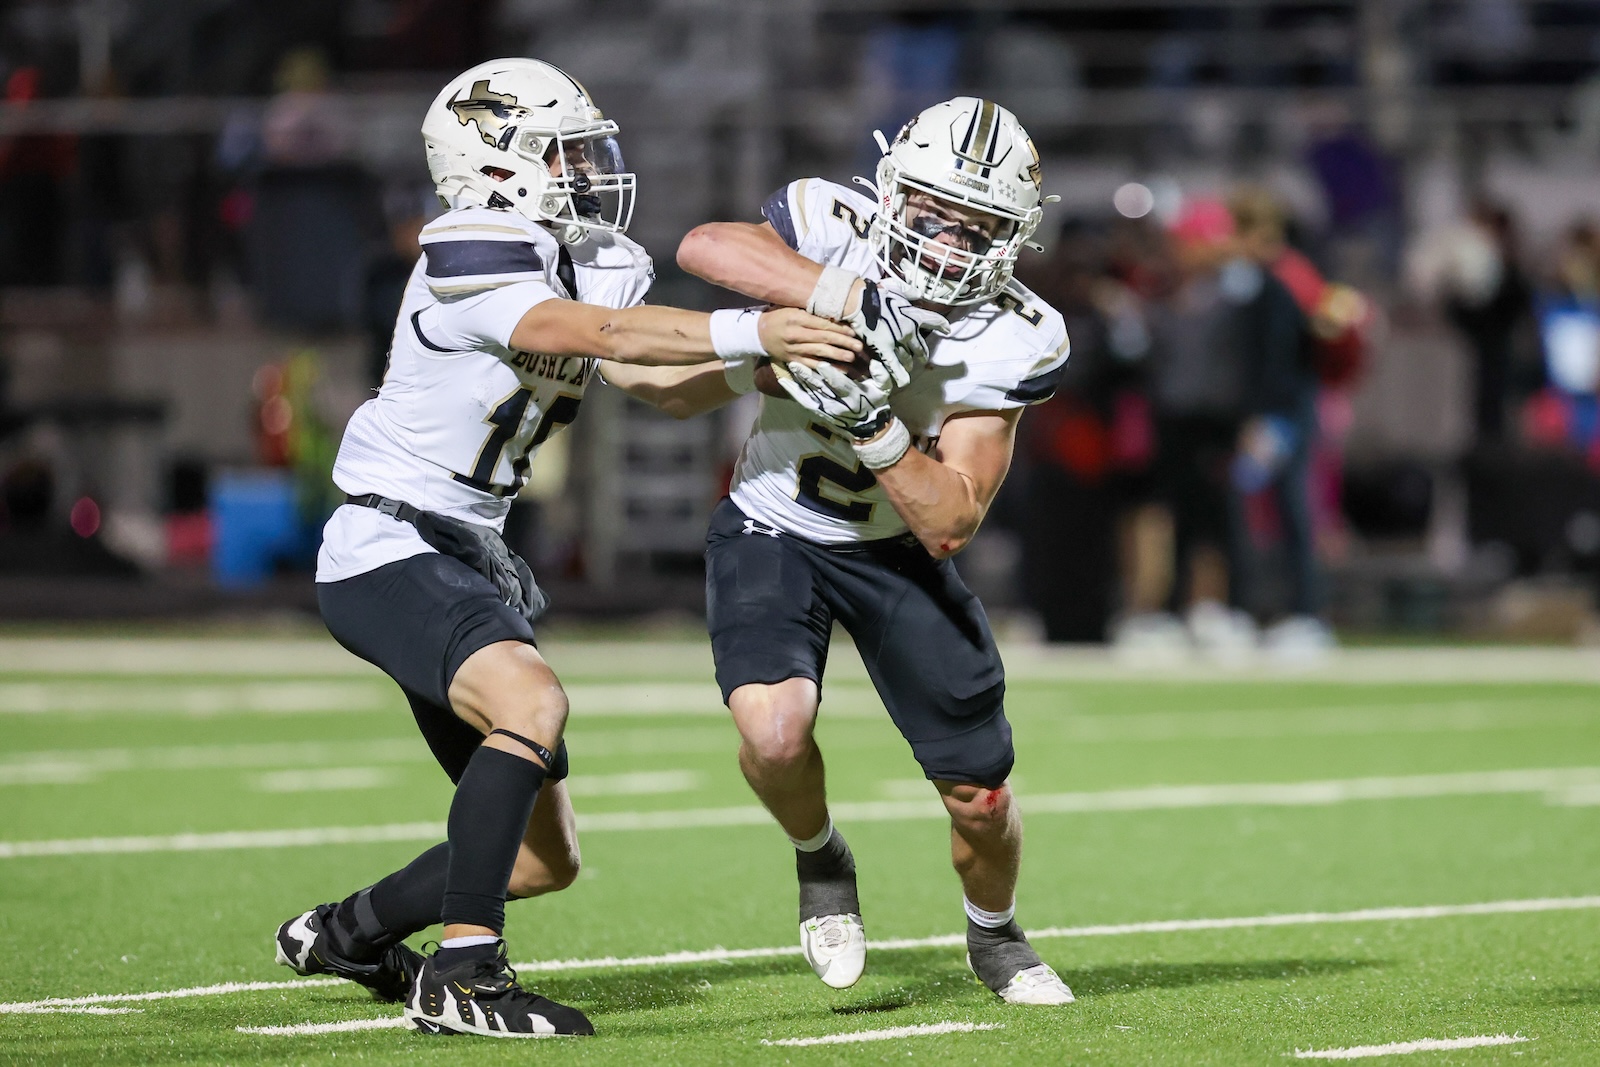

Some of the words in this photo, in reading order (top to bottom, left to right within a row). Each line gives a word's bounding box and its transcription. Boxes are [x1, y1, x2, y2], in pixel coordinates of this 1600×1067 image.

[949, 172, 990, 193] FALCONS
[829, 196, 871, 242] 2
[994, 290, 1046, 330] 2
[791, 418, 880, 524] 2
